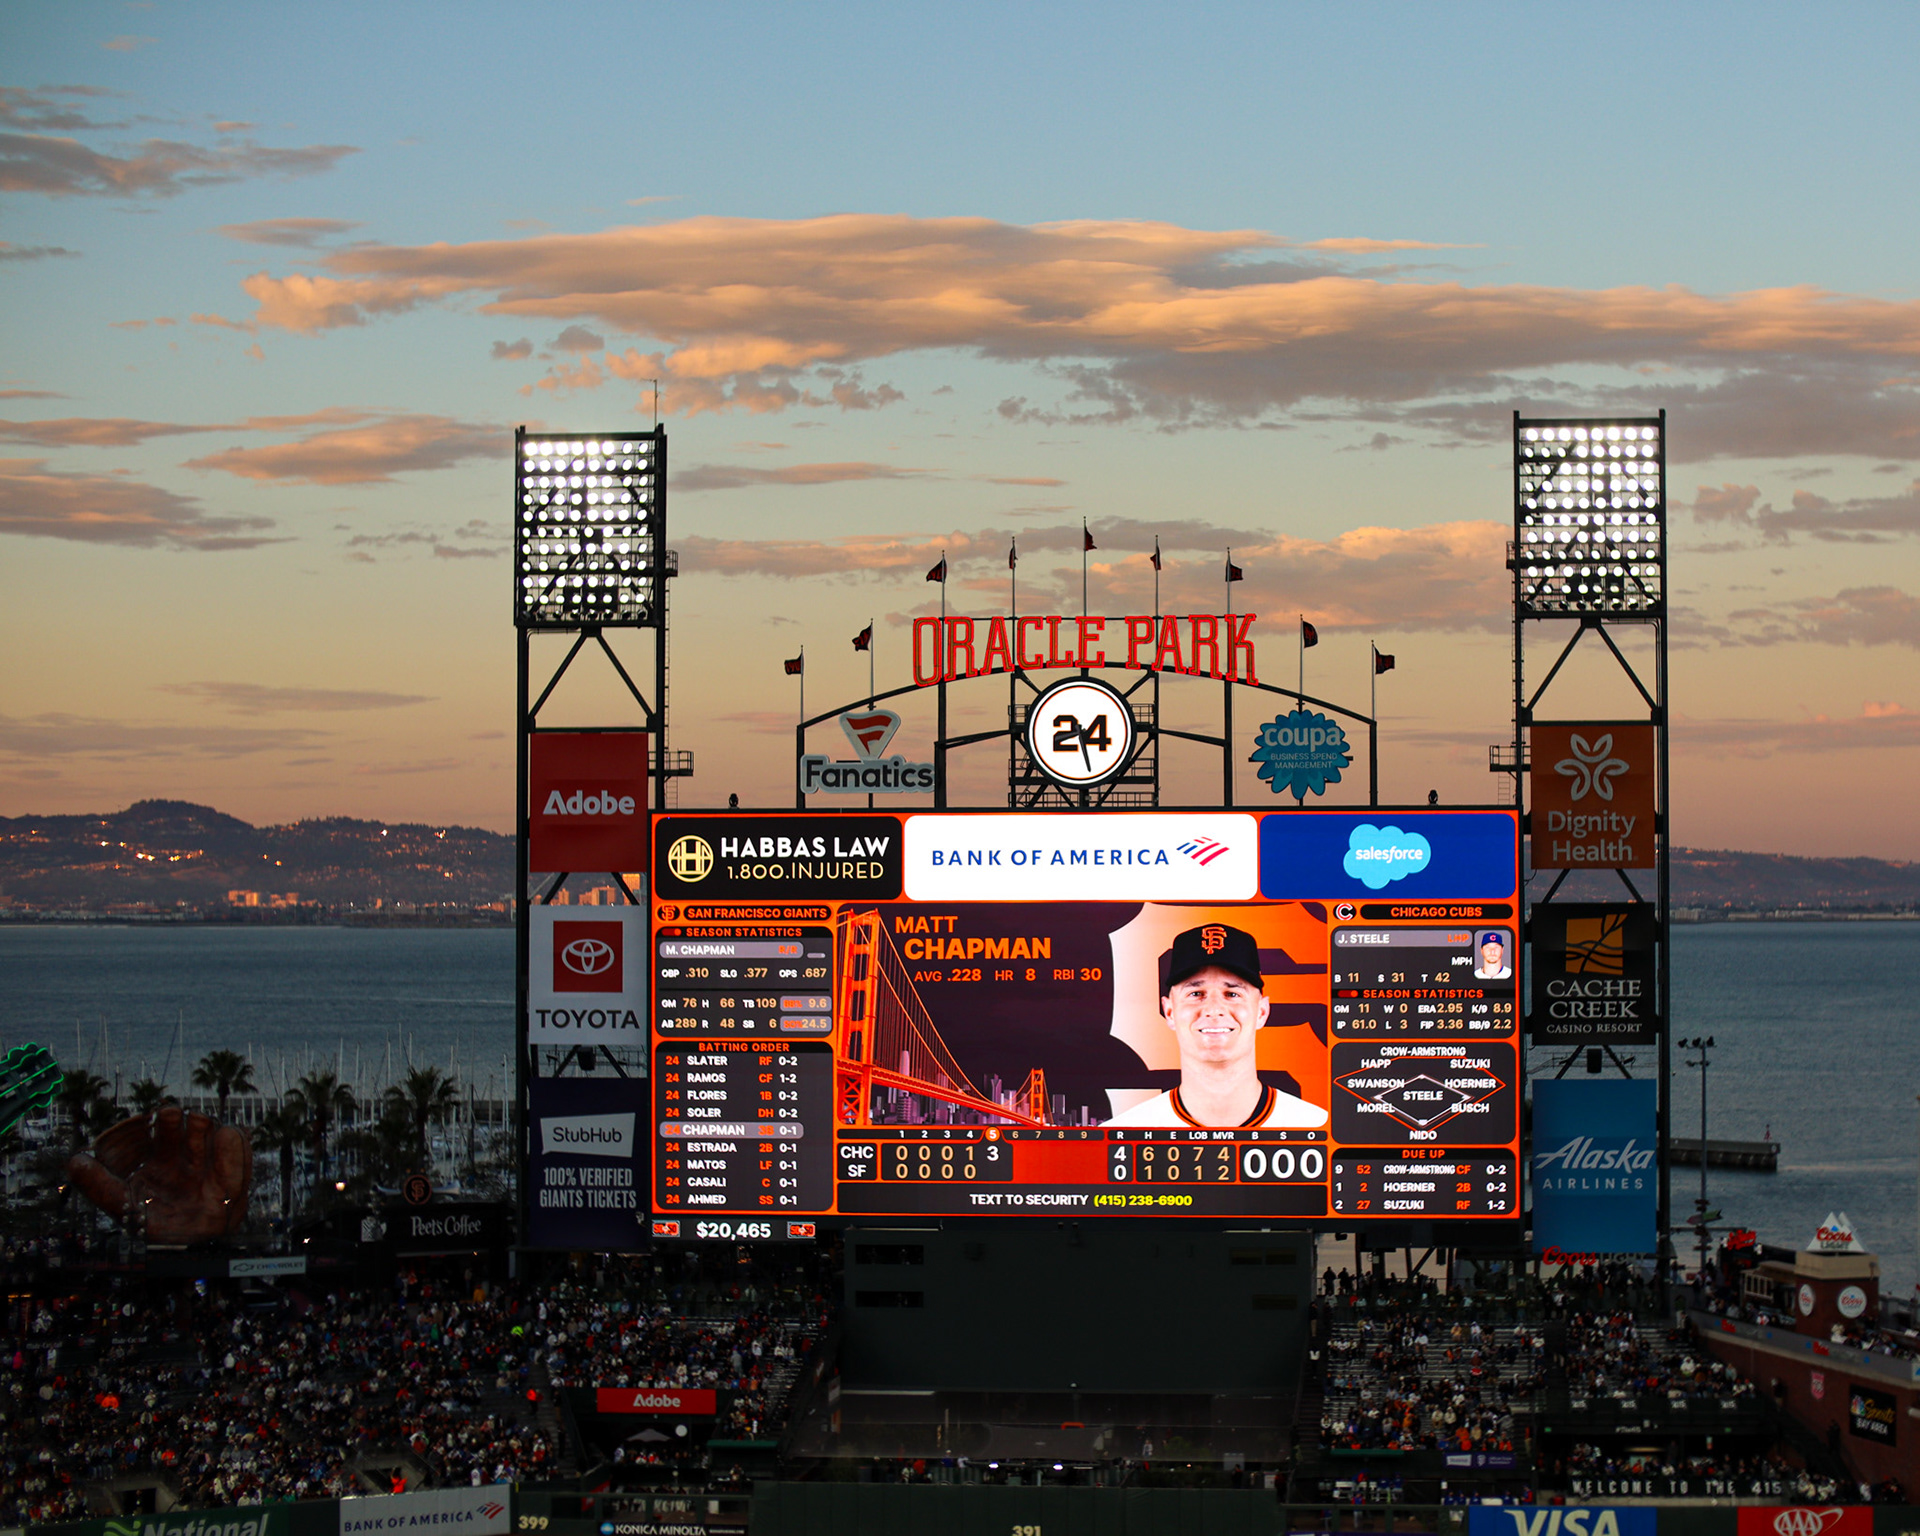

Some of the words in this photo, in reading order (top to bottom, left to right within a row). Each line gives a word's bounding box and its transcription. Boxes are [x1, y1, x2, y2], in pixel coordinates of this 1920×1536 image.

[913, 615, 1105, 686] ORACLE
[1125, 614, 1259, 686] PARK
[1053, 714, 1112, 753] 24
[1264, 727, 1341, 752] coupa
[1270, 753, 1309, 761] BUSINESS
[1311, 753, 1338, 761] SPEND
[1275, 761, 1332, 769] MANAGEMENT
[806, 760, 933, 788] Fanatics
[543, 790, 636, 815] Adobe
[1548, 809, 1636, 839] Dignity
[721, 837, 826, 858] HABBAS
[834, 837, 889, 857] LAW
[1553, 839, 1633, 862] Health
[932, 850, 1002, 866] BANK
[1011, 850, 1042, 866] OF
[1050, 849, 1169, 866] AMERICA
[1356, 846, 1423, 863] salesforce
[727, 862, 884, 880] 1.800.INJURED
[687, 908, 712, 919] SAN
[714, 908, 781, 919] FRANCISCO
[783, 908, 828, 919] GIANTS
[1391, 907, 1447, 917] CHICAGO
[1450, 907, 1482, 917] CUBS
[895, 916, 958, 934] MATT
[686, 928, 732, 937] SEASON
[735, 928, 802, 937] STATISTICS
[1350, 934, 1390, 944] STEELE
[1447, 934, 1469, 943] LHP
[681, 945, 735, 955] CHAPMAN
[904, 938, 1051, 960] CHAPMAN
[1452, 957, 1472, 966] MPH
[661, 969, 680, 978] OBP
[685, 967, 709, 978] .310
[720, 969, 738, 978] SLG
[744, 967, 768, 978] .377
[779, 969, 798, 978] OPS
[802, 967, 827, 978] .687
[914, 971, 942, 982] AVG
[947, 969, 982, 982] .228
[995, 970, 1013, 981] HR
[1025, 968, 1036, 981] 8
[1053, 969, 1074, 980] RBI
[1080, 968, 1102, 981] 30
[1434, 972, 1450, 982] 42
[1363, 990, 1410, 998] SEASON
[1414, 990, 1484, 998] STATISTICS
[1547, 979, 1642, 998] CACHE
[682, 998, 697, 1008] 76
[719, 998, 735, 1008] 66
[756, 998, 777, 1008] 109
[1437, 1003, 1463, 1013] 2.95
[1549, 1001, 1639, 1018] CREEK
[536, 1009, 640, 1029] TOYOTA
[675, 1018, 697, 1029] 289
[719, 1018, 735, 1029] 48
[802, 1019, 827, 1029] 24.5
[1352, 1019, 1377, 1029] 61.0
[1436, 1019, 1464, 1029] 3.36
[1547, 1024, 1592, 1034] CASINO
[1597, 1023, 1642, 1033] RESORT
[699, 1043, 748, 1052] BATTING
[752, 1043, 790, 1052] ORDER
[1380, 1047, 1466, 1056] CROW-ARMSTRONG
[687, 1056, 728, 1066] SLATER
[1361, 1059, 1391, 1068] HAPP
[1450, 1059, 1490, 1068] SUZUKI
[687, 1073, 726, 1083] RAMOS
[1348, 1079, 1405, 1088] SWANSON
[1445, 1079, 1496, 1088] HOERNER
[687, 1091, 727, 1100] FLORES
[1403, 1091, 1443, 1101] STEELE
[687, 1108, 722, 1118] SOLER
[1357, 1103, 1395, 1113] MOREL
[1451, 1103, 1489, 1113] BUSCH
[553, 1126, 622, 1143] StubHub
[682, 1125, 745, 1135] CHAPMAN
[1409, 1131, 1437, 1140] NIDO
[687, 1143, 737, 1153] ESTRADA
[840, 1146, 874, 1159] CHC
[896, 1146, 908, 1161] 0
[918, 1146, 931, 1161] 0
[941, 1146, 953, 1161] 0
[965, 1146, 974, 1161] 1
[987, 1146, 999, 1161] 3
[1113, 1146, 1127, 1162] 4
[1142, 1146, 1154, 1162] 6
[1167, 1146, 1180, 1162] 0
[1193, 1146, 1204, 1162] 7
[1217, 1146, 1230, 1162] 4
[1402, 1150, 1425, 1158] DUE
[1429, 1150, 1445, 1158] UP
[1535, 1136, 1655, 1174] Alaska
[687, 1160, 727, 1170] MATOS
[1243, 1148, 1267, 1179] 0
[1271, 1148, 1295, 1179] 0
[1300, 1148, 1323, 1179] 0
[848, 1164, 867, 1177] SF
[896, 1164, 908, 1179] 0
[918, 1164, 931, 1179] 0
[941, 1164, 953, 1179] 0
[964, 1164, 976, 1179] 0
[1114, 1165, 1127, 1180] 0
[1144, 1165, 1152, 1180] 1
[1167, 1165, 1180, 1180] 0
[1194, 1165, 1202, 1180] 1
[1218, 1165, 1230, 1180] 2
[1383, 1165, 1455, 1174] CROW-ARMSTRONG
[544, 1167, 577, 1186] 100%
[579, 1167, 633, 1187] VERIFIED
[687, 1178, 726, 1187] CASALI
[761, 1178, 771, 1187] C
[1383, 1183, 1435, 1192] HOERNER
[1542, 1178, 1643, 1190] AIRLINES
[540, 1189, 584, 1208] GIANTS
[586, 1190, 637, 1208] TICKETS
[687, 1195, 727, 1204] AHMED
[970, 1194, 1003, 1205] TEXT
[1005, 1194, 1023, 1205] TO
[1025, 1194, 1088, 1205] SECURITY
[1094, 1195, 1126, 1207] (415)
[1129, 1195, 1192, 1206] 238-6900
[1383, 1200, 1424, 1209] SUZUKI
[410, 1215, 442, 1237] Peet's
[444, 1215, 482, 1237] Coffee
[696, 1221, 771, 1240] $20,465
[1816, 1227, 1853, 1242] Coors
[1542, 1245, 1597, 1266] Coors
[633, 1394, 681, 1407] Adobe
[1871, 1421, 1888, 1435] AREA
[1572, 1480, 1652, 1494] WELCOME
[1669, 1480, 1689, 1494] TO
[1706, 1480, 1736, 1494] THE
[1751, 1480, 1782, 1494] 415
[142, 1513, 269, 1536] National
[344, 1519, 383, 1532] BANK
[388, 1517, 405, 1529] OF
[409, 1511, 474, 1526] AMERICA
[518, 1515, 549, 1530] 399
[1503, 1510, 1621, 1536] VISA
[1779, 1511, 1819, 1536] AAA
[615, 1525, 658, 1536] KONICA
[659, 1526, 706, 1536] MINOLTA
[1011, 1525, 1042, 1536] 391
